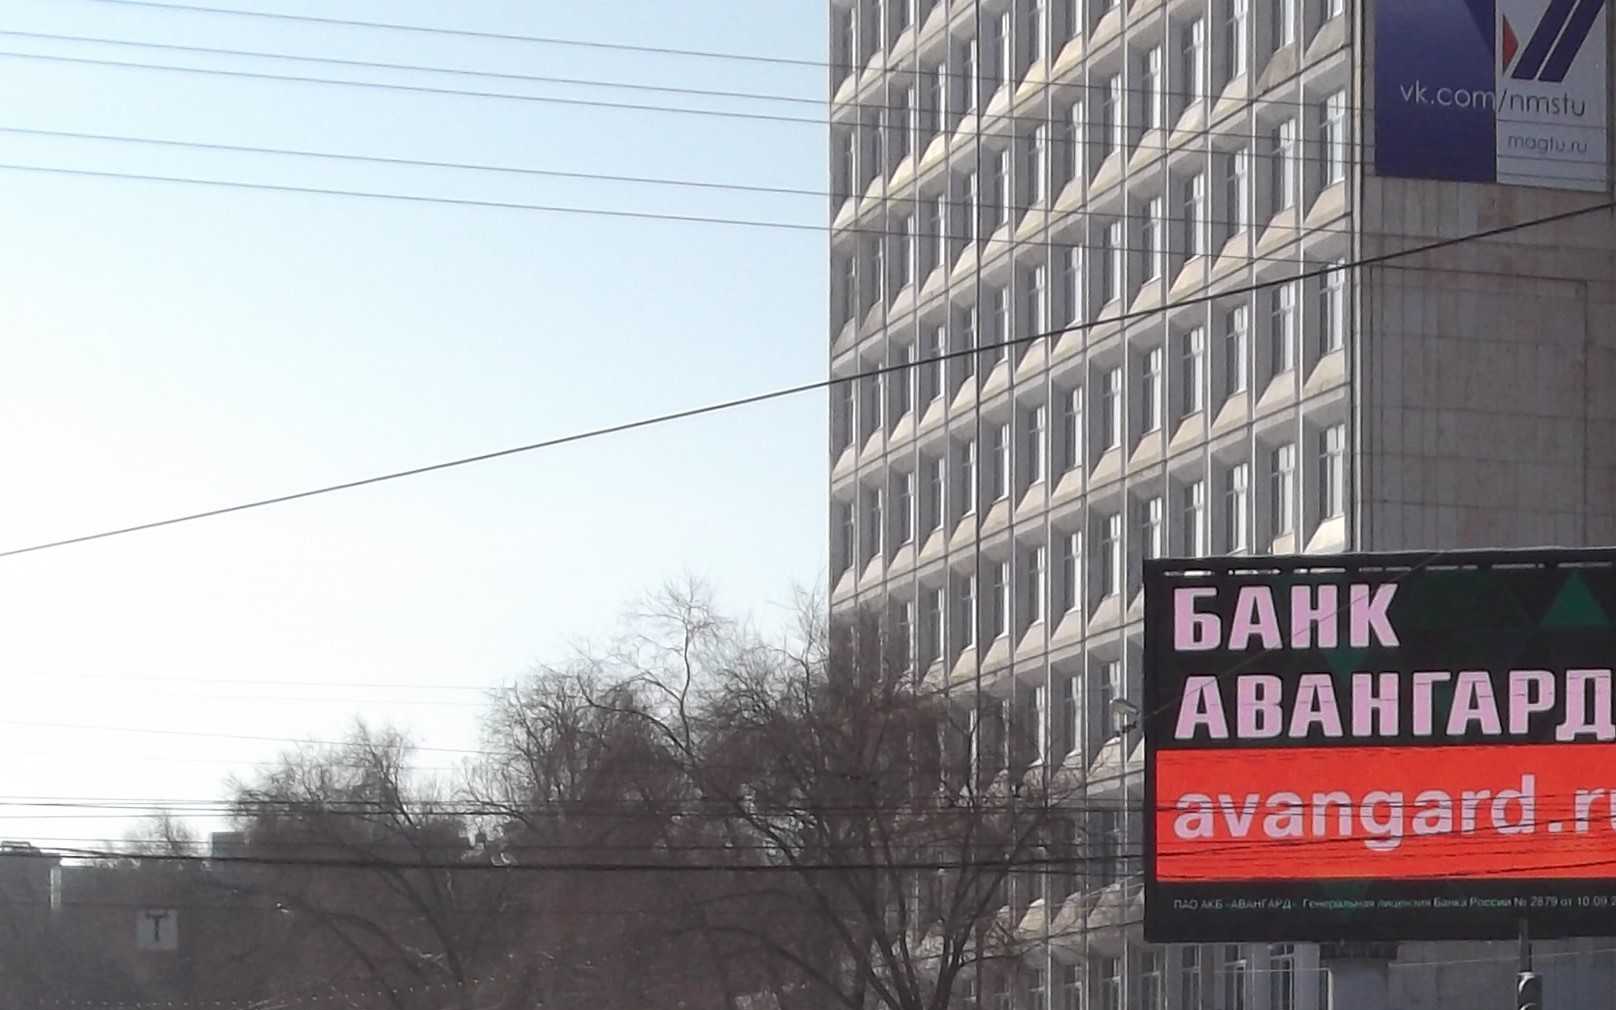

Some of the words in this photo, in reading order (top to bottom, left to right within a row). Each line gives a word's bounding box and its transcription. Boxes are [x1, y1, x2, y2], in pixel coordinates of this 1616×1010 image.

[1400, 79, 1586, 117] vk.com/nmstu
[1507, 133, 1588, 156] magtu.ru
[1173, 582, 1400, 652] БАНК
[1173, 668, 1616, 743] АВАНГАРД
